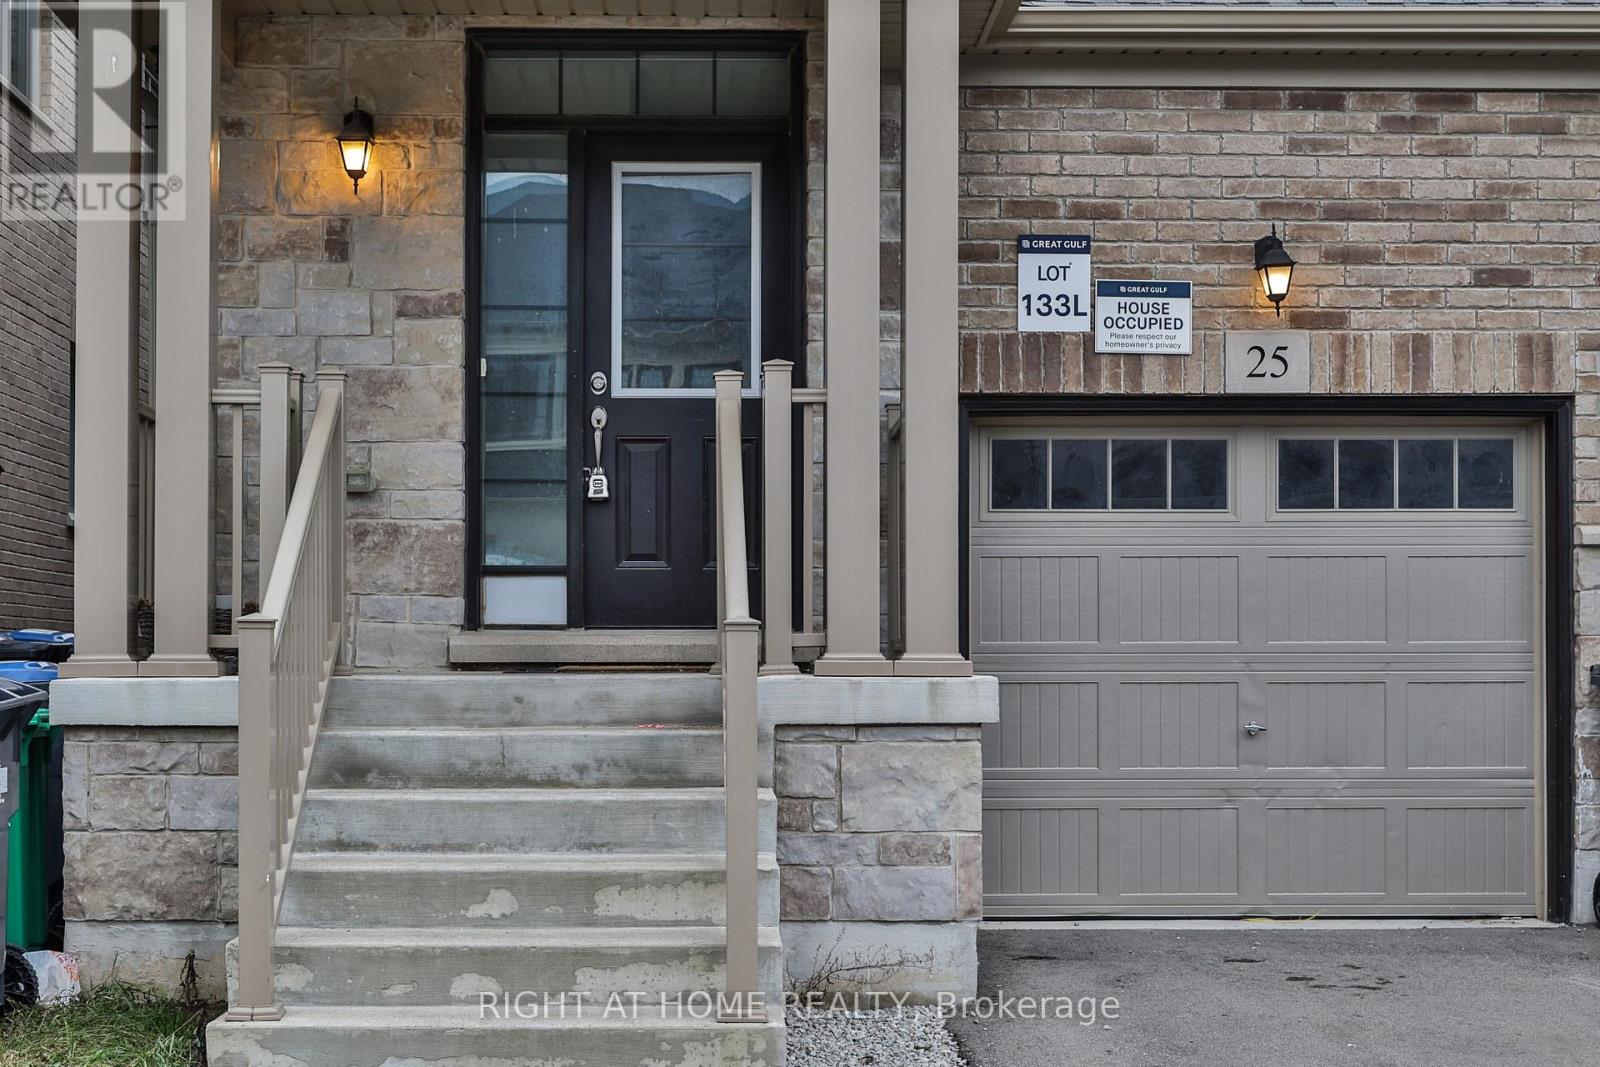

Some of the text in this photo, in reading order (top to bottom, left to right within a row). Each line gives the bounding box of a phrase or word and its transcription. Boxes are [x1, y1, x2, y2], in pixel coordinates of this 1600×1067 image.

[1032, 240, 1087, 249] GREAT GULF
[1038, 265, 1071, 281] LOT
[1022, 293, 1088, 317] 133L
[1117, 301, 1170, 315] HOUSE
[1103, 316, 1184, 330] OCCUPIED
[1109, 332, 1134, 340] Please
[1135, 333, 1163, 342] respect
[1155, 341, 1182, 350] privacy
[1246, 345, 1289, 378] 25
